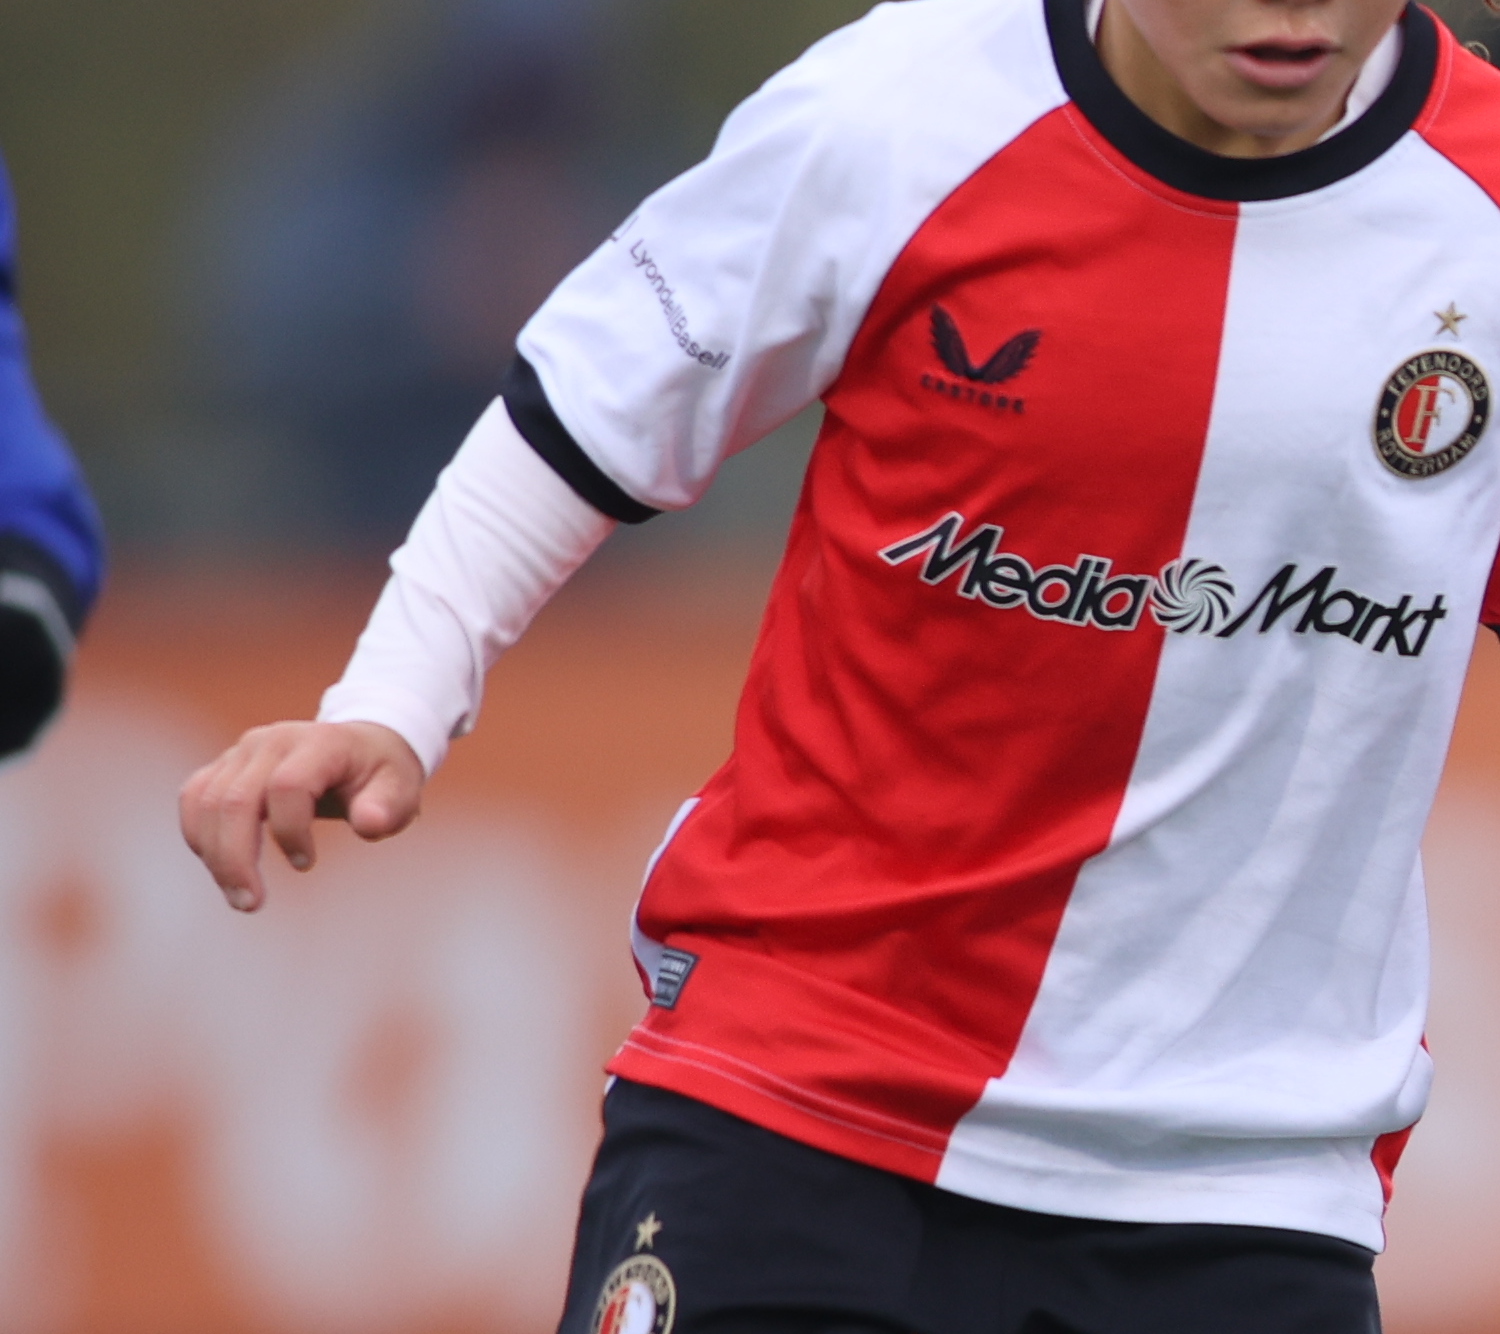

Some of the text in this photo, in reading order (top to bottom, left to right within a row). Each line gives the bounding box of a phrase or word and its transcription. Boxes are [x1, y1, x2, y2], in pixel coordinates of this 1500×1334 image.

[1403, 384, 1456, 443] F
[877, 511, 1447, 658] Media Markt
